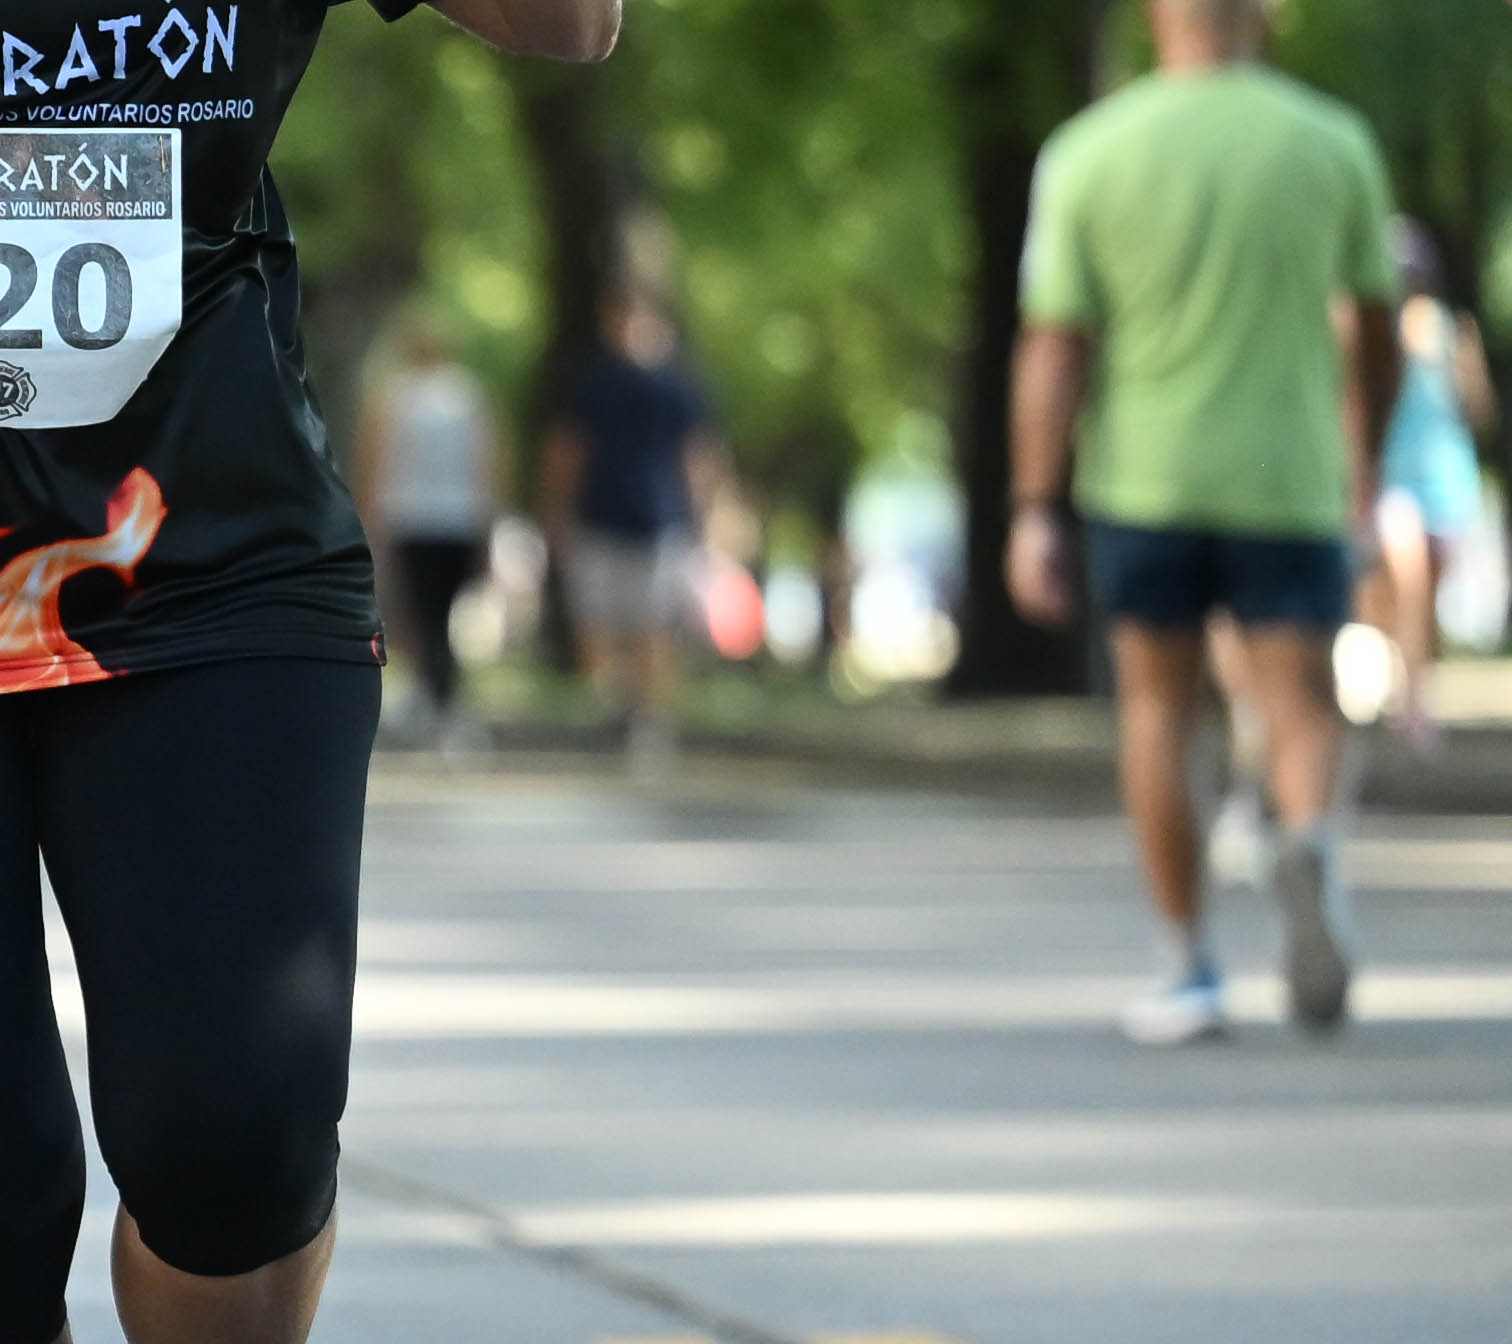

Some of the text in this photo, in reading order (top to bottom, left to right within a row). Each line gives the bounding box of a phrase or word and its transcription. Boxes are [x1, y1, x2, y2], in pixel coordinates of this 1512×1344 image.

[26, 103, 172, 124] VOLUNTARIOS
[177, 98, 253, 122] ROSARIO
[10, 201, 102, 218] VOLUNTARIOS
[106, 201, 166, 217] ROSARIO
